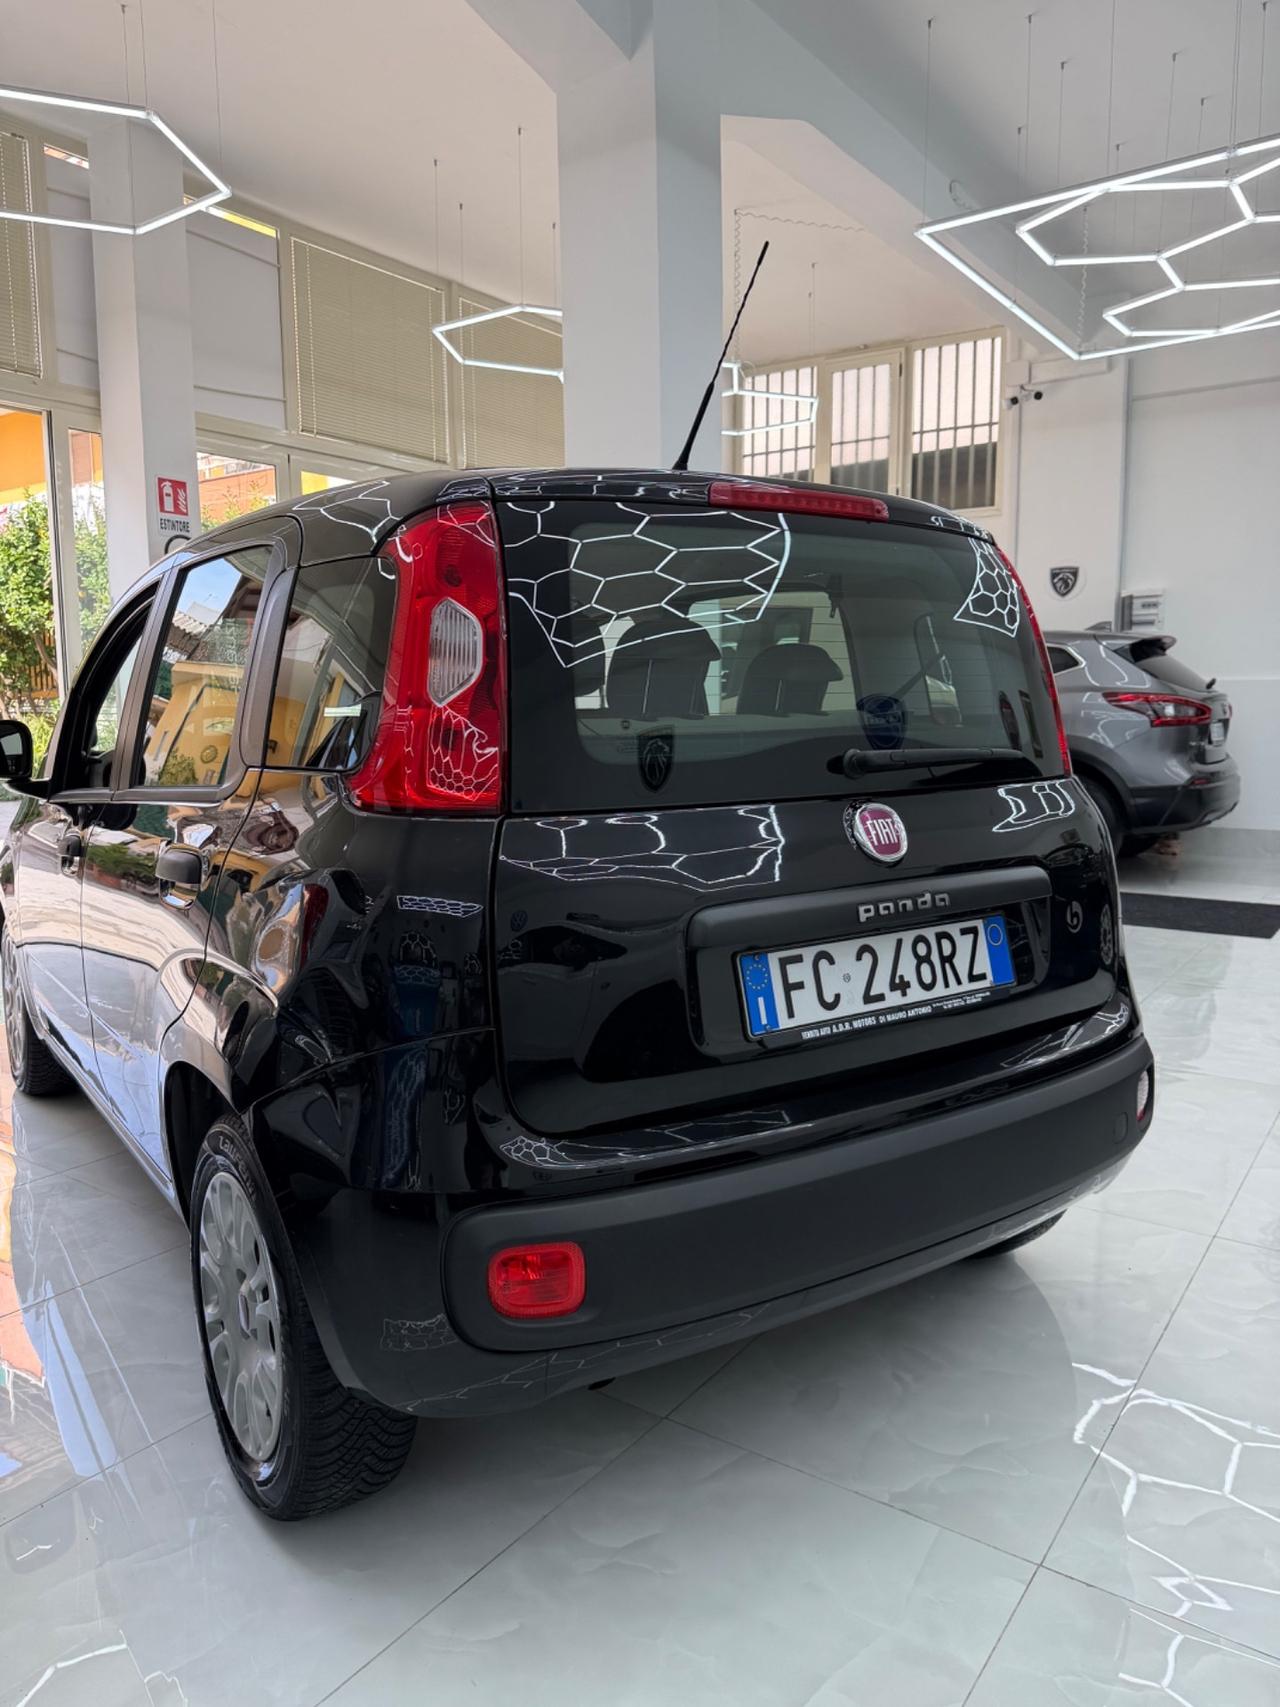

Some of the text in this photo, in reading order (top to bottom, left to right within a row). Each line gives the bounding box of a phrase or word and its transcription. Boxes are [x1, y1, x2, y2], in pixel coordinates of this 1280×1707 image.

[159, 518, 191, 533] ESTINTORE
[866, 818, 899, 847] FIAT
[857, 891, 951, 923] panda
[778, 925, 988, 1019] FC 248RZ
[757, 996, 768, 1025] I
[852, 1016, 877, 1029] MOTORS
[886, 1010, 907, 1022] MAURO
[907, 1005, 933, 1017] ANTONIO
